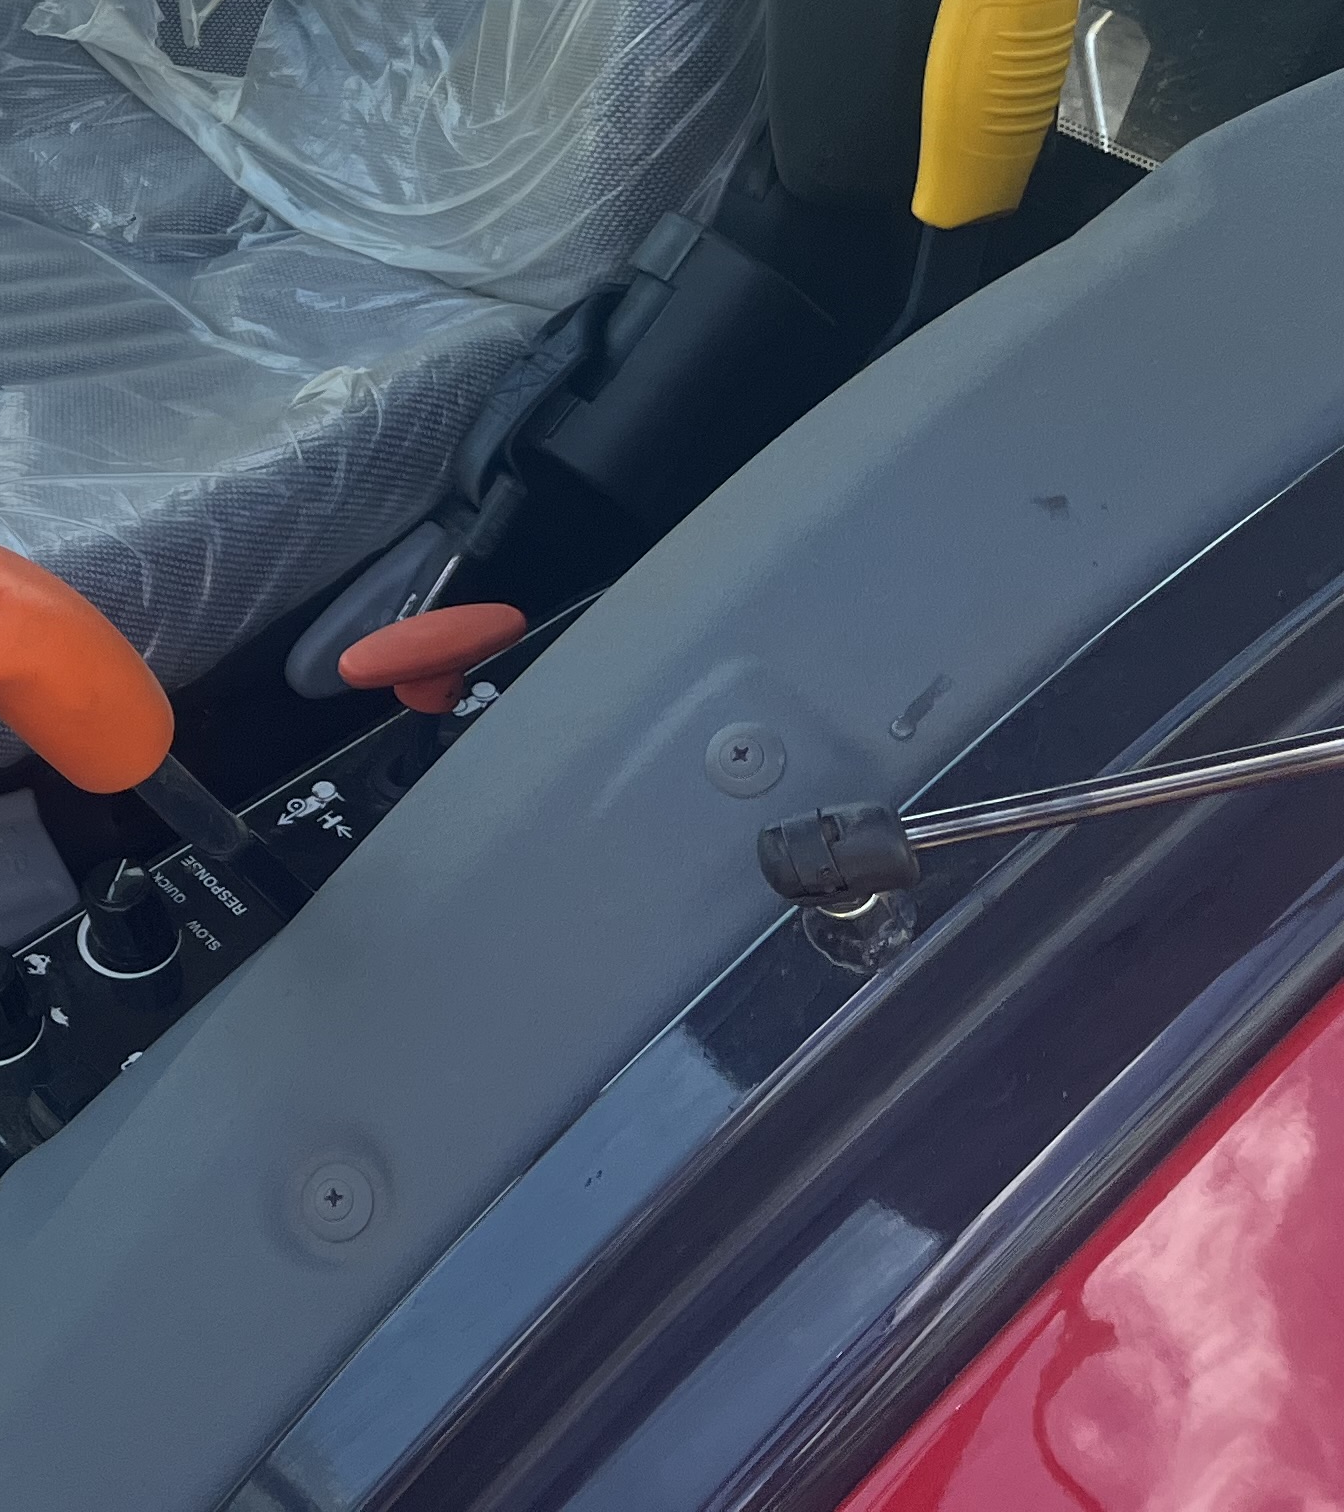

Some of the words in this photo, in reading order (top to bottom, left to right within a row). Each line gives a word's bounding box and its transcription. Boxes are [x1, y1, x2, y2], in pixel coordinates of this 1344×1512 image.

[152, 871, 187, 904] QUICK
[180, 855, 248, 916] RESPONSE
[186, 920, 222, 951] SLOW
